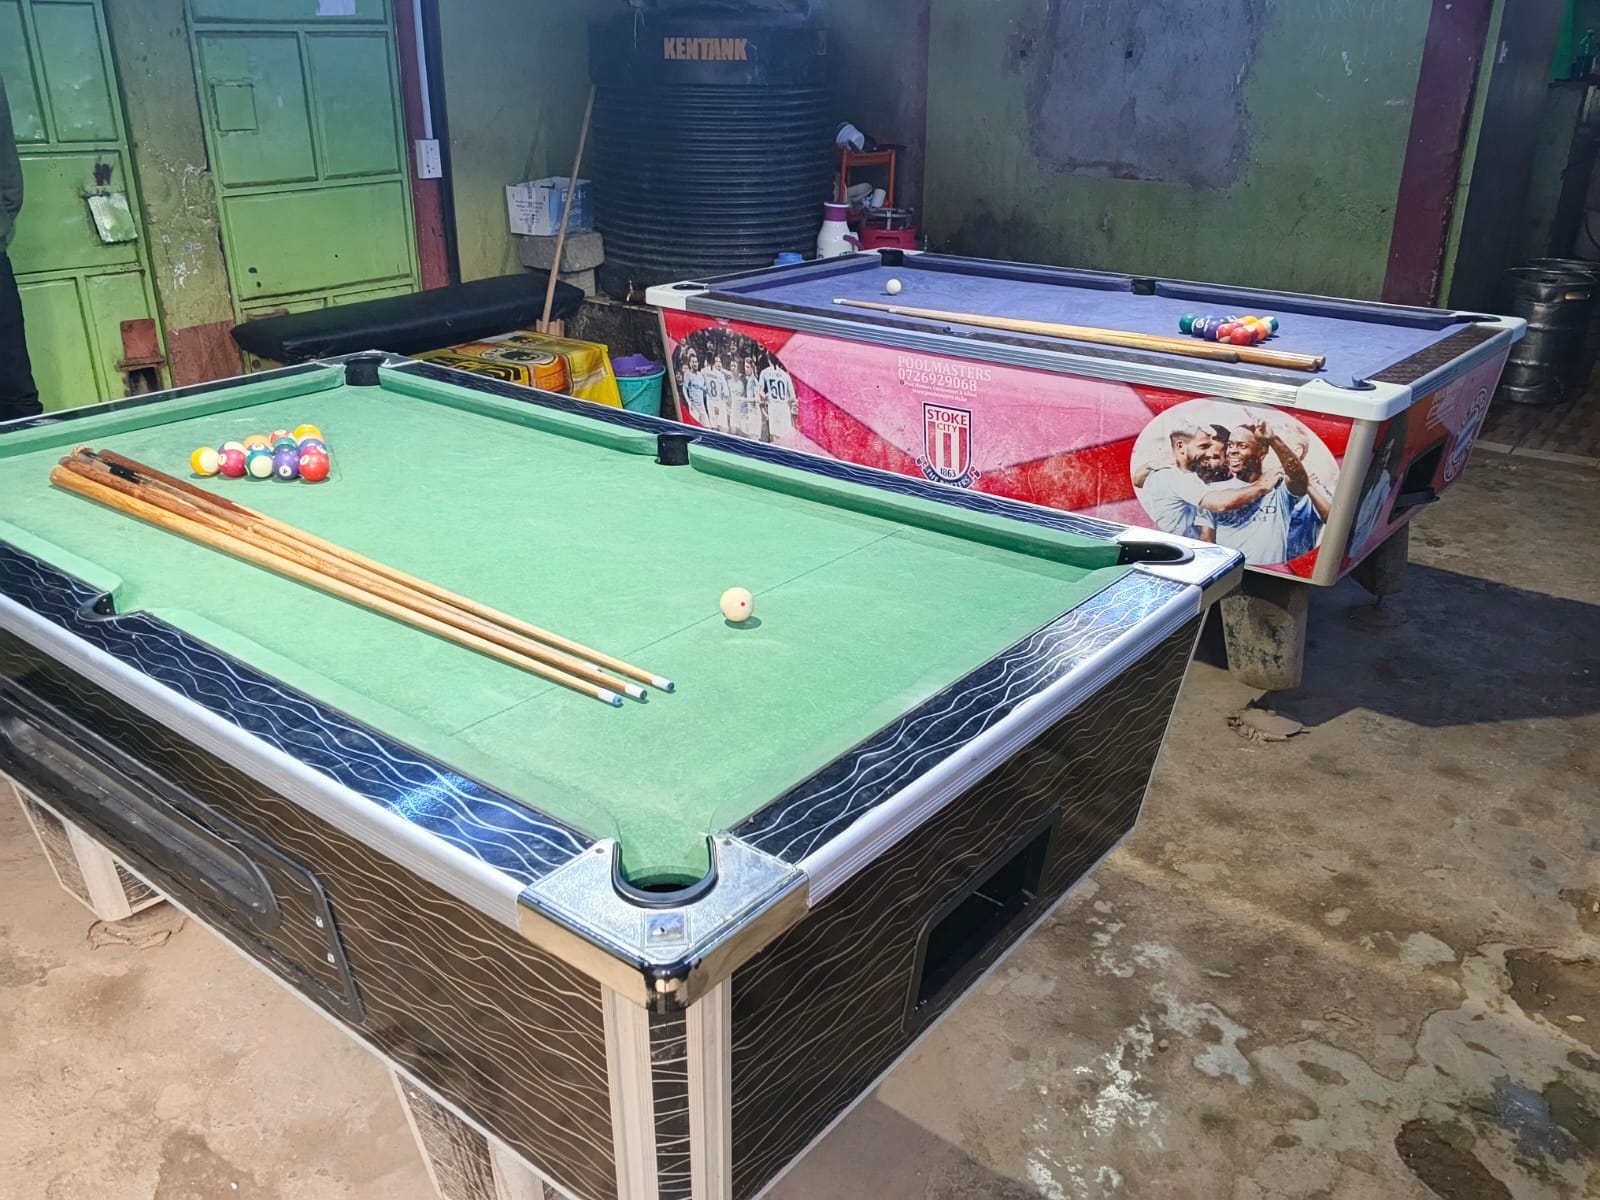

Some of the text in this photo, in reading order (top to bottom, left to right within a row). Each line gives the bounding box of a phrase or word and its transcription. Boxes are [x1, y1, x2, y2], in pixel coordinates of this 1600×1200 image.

[664, 37, 747, 60] KENTANK
[897, 355, 992, 381] POOLMASTERS
[769, 379, 785, 400] 50
[898, 367, 977, 392] 0726929068
[927, 409, 968, 426] STOKE
[937, 422, 957, 432] CITY
[940, 467, 957, 478] 1863
